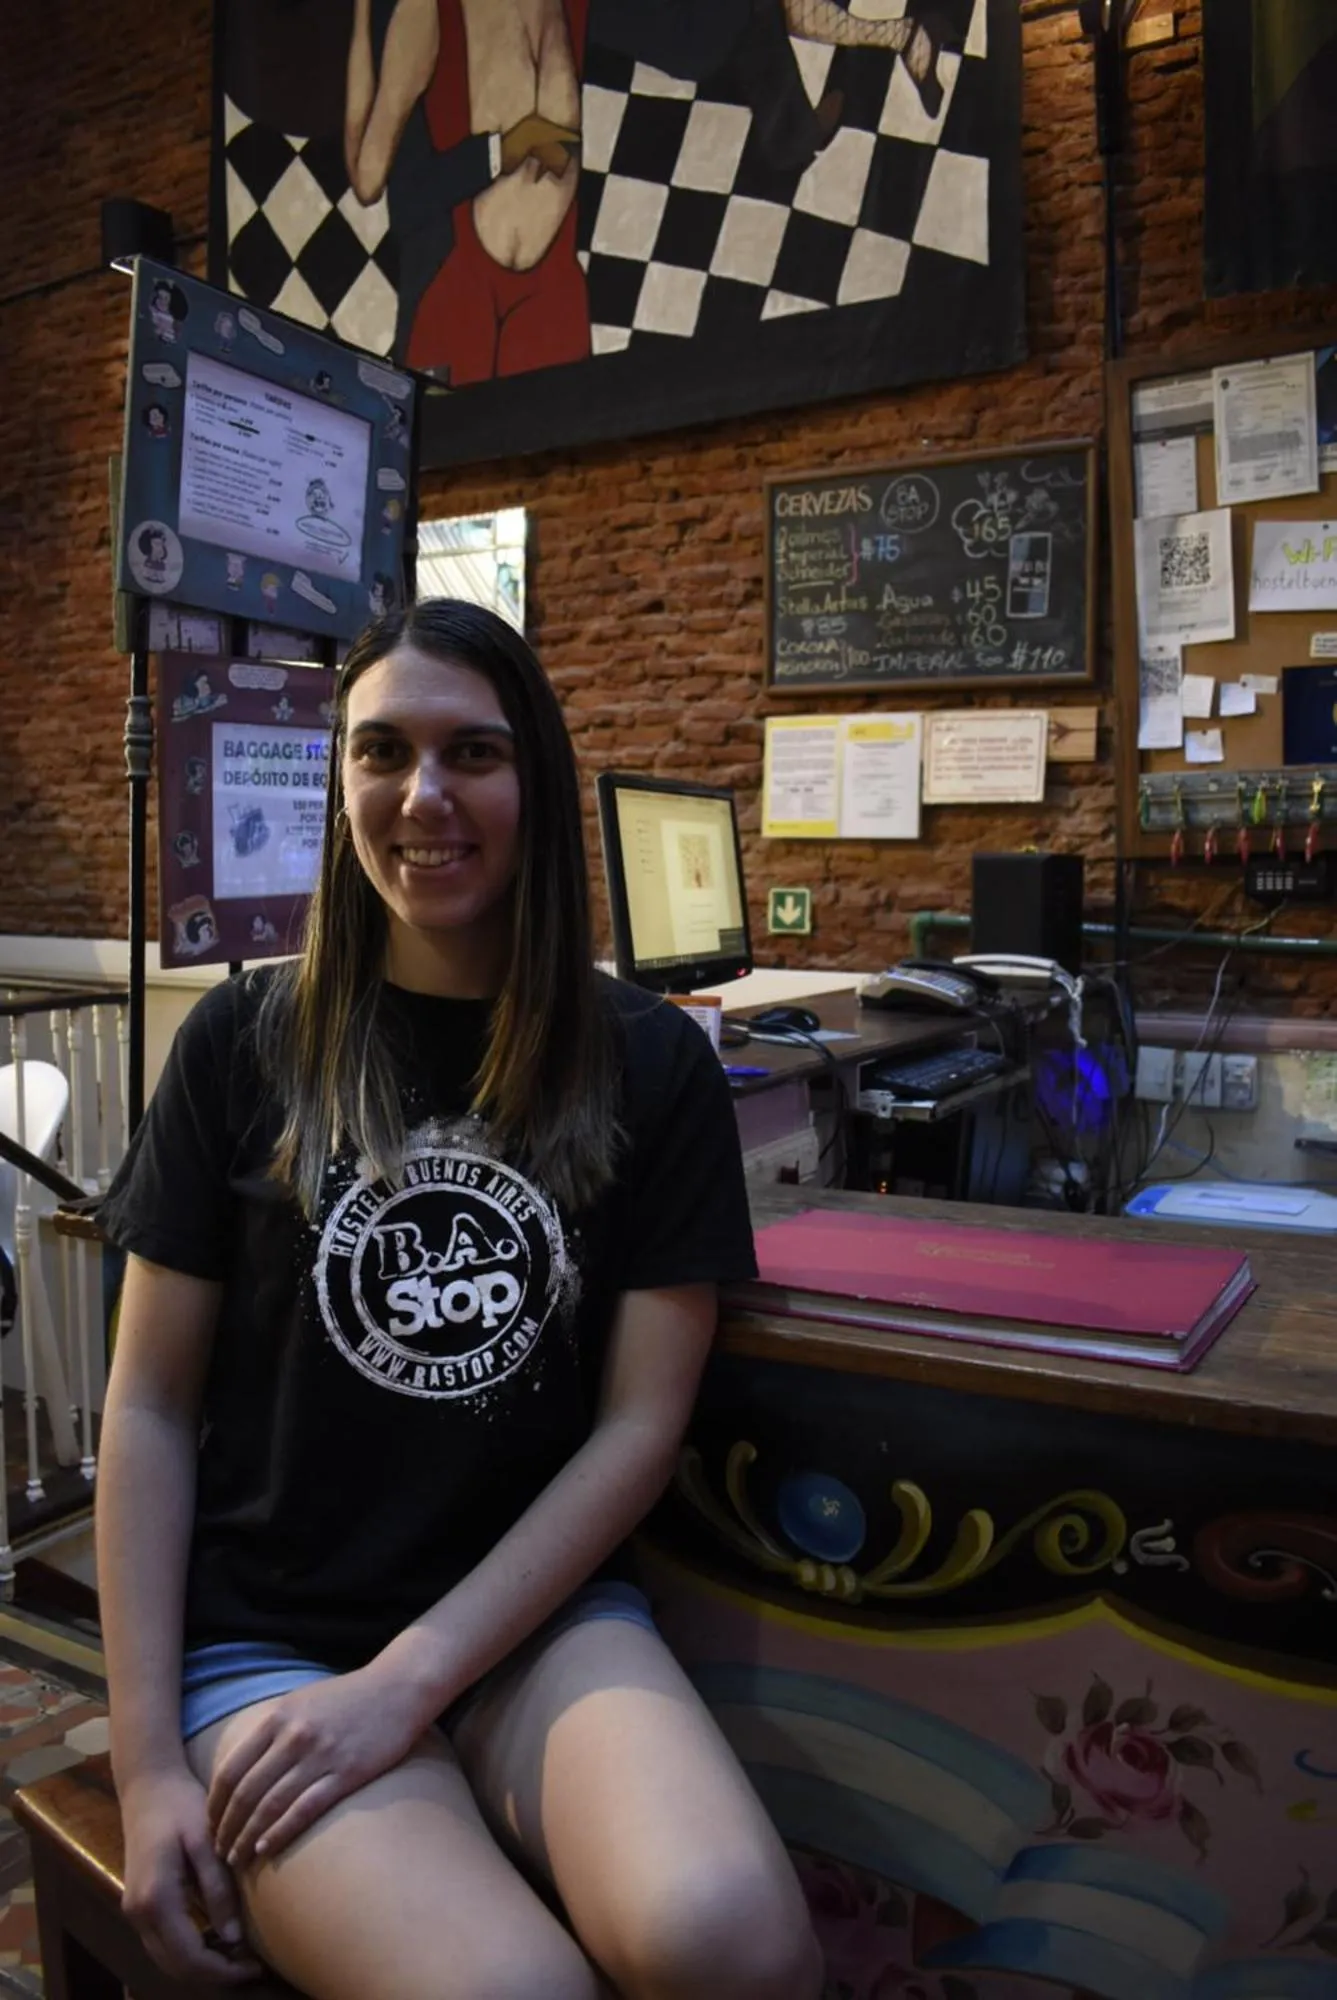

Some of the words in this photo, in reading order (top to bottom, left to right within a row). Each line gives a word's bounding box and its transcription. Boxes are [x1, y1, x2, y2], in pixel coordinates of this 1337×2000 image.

[775, 485, 874, 518] CERVEZAS
[884, 501, 930, 523] STOP
[884, 583, 934, 614] Agua
[223, 740, 303, 760] BAGGAGE
[223, 767, 289, 787] DEPÓSITO
[292, 772, 309, 787] DE
[329, 1186, 386, 1257] HOSTEL
[405, 1158, 482, 1188] BUENOS
[484, 1170, 538, 1223] AIRES
[385, 1270, 522, 1337] Stop
